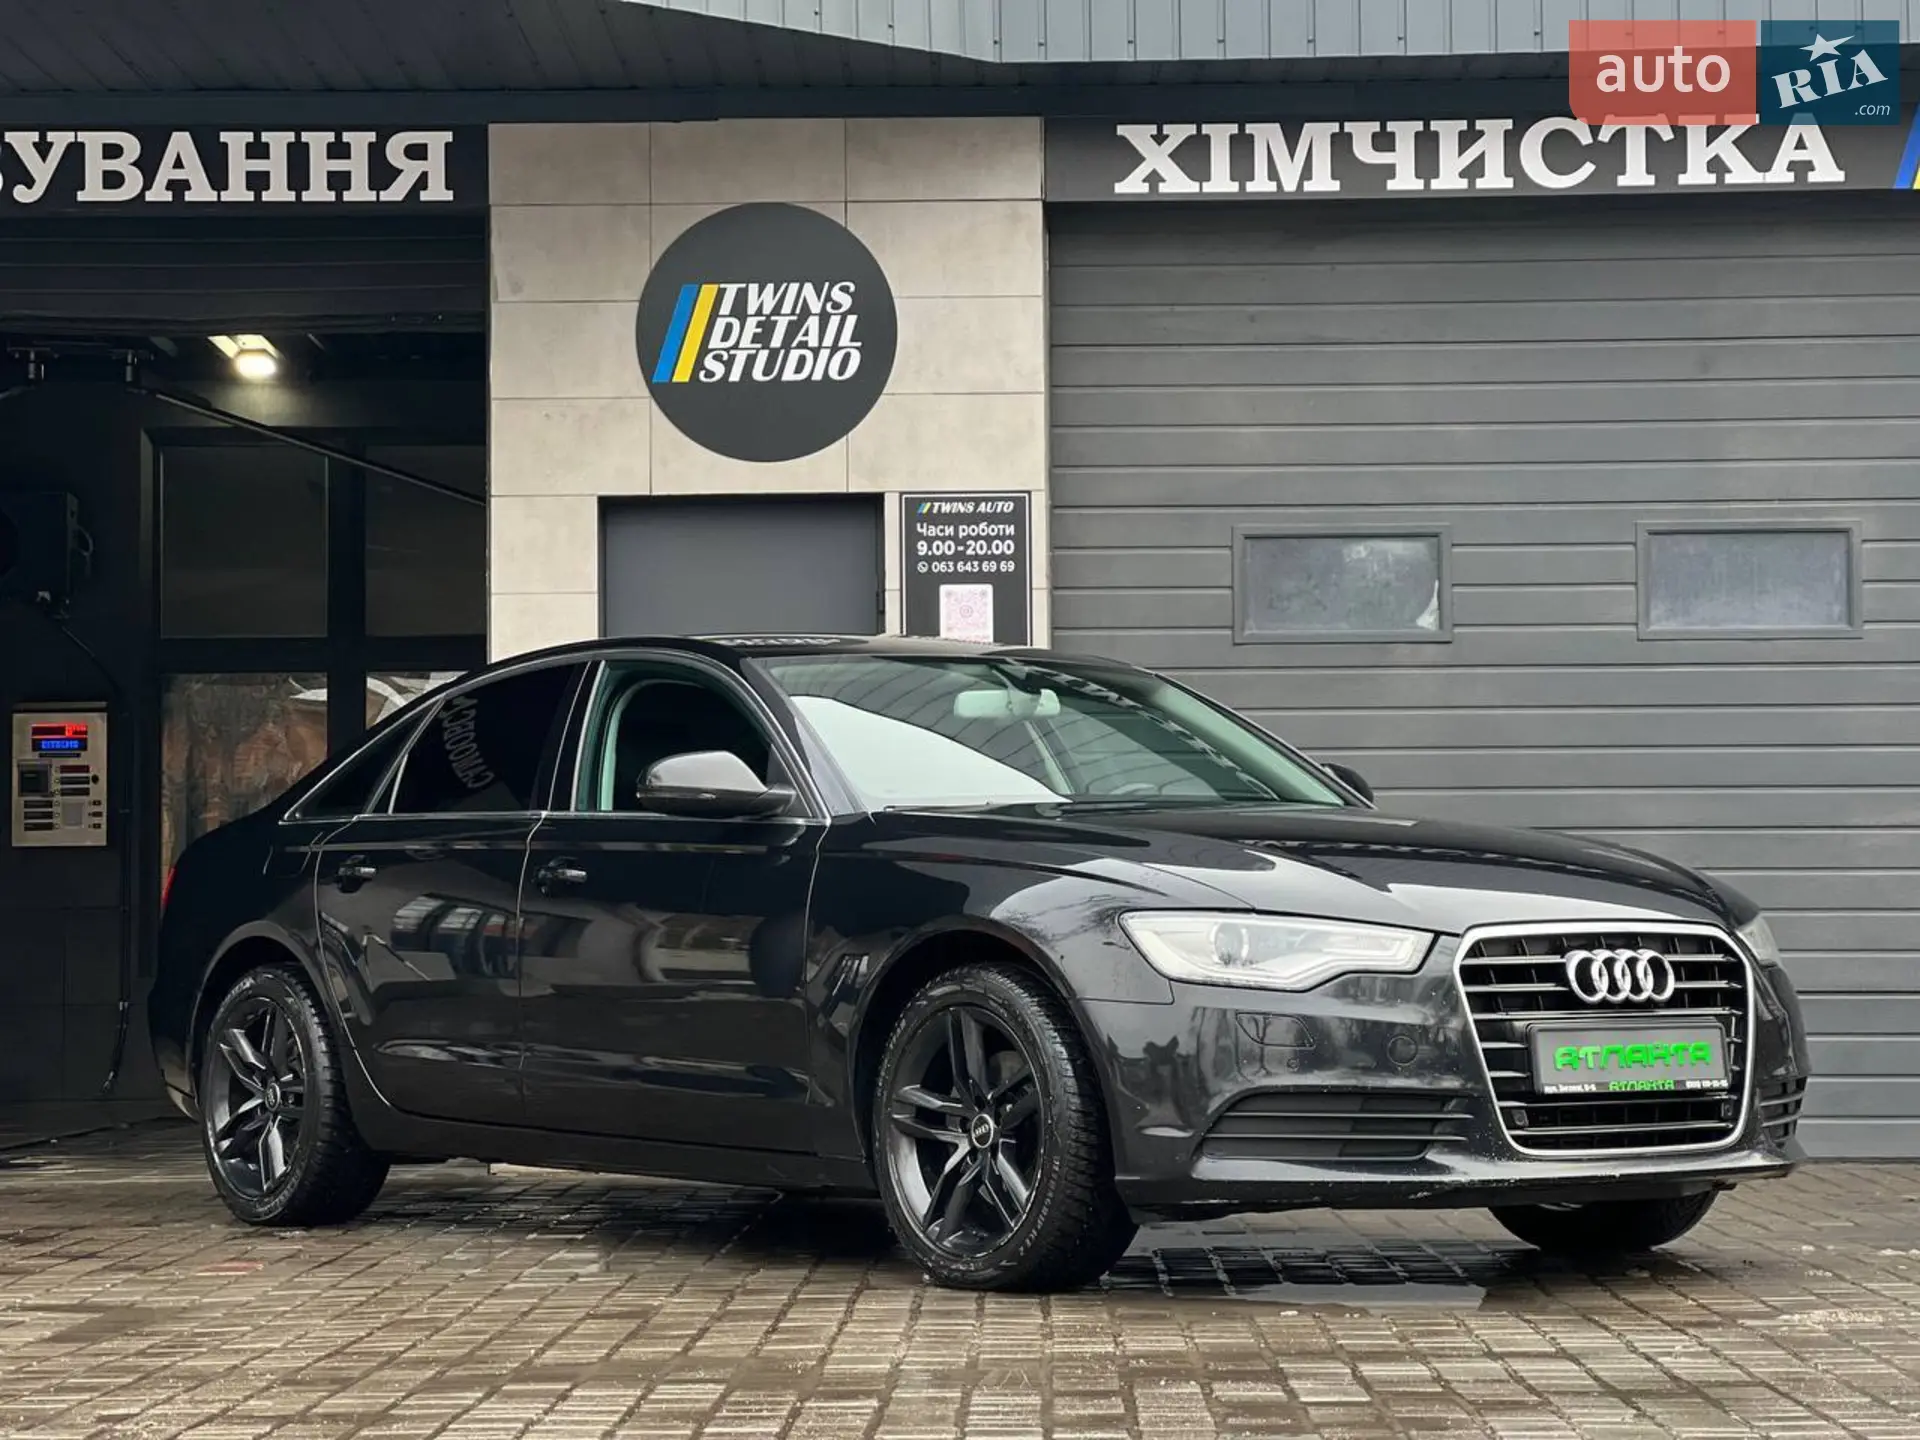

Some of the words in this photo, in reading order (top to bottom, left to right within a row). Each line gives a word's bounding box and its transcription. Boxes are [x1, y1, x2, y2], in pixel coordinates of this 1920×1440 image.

[0, 130, 454, 204] УВАННЯ
[1114, 112, 1846, 194] ХІМЧИСТКА
[718, 281, 856, 316] TWINS
[707, 314, 863, 350] DETAIL
[698, 348, 862, 383] STUDIO
[932, 502, 975, 514] TWINS
[976, 501, 1015, 514] AUTO
[916, 522, 955, 537] Часи
[958, 521, 1015, 539] роботи
[931, 561, 954, 573] 063
[956, 561, 980, 573] 643
[981, 561, 997, 573] 69
[999, 560, 1015, 573] 69
